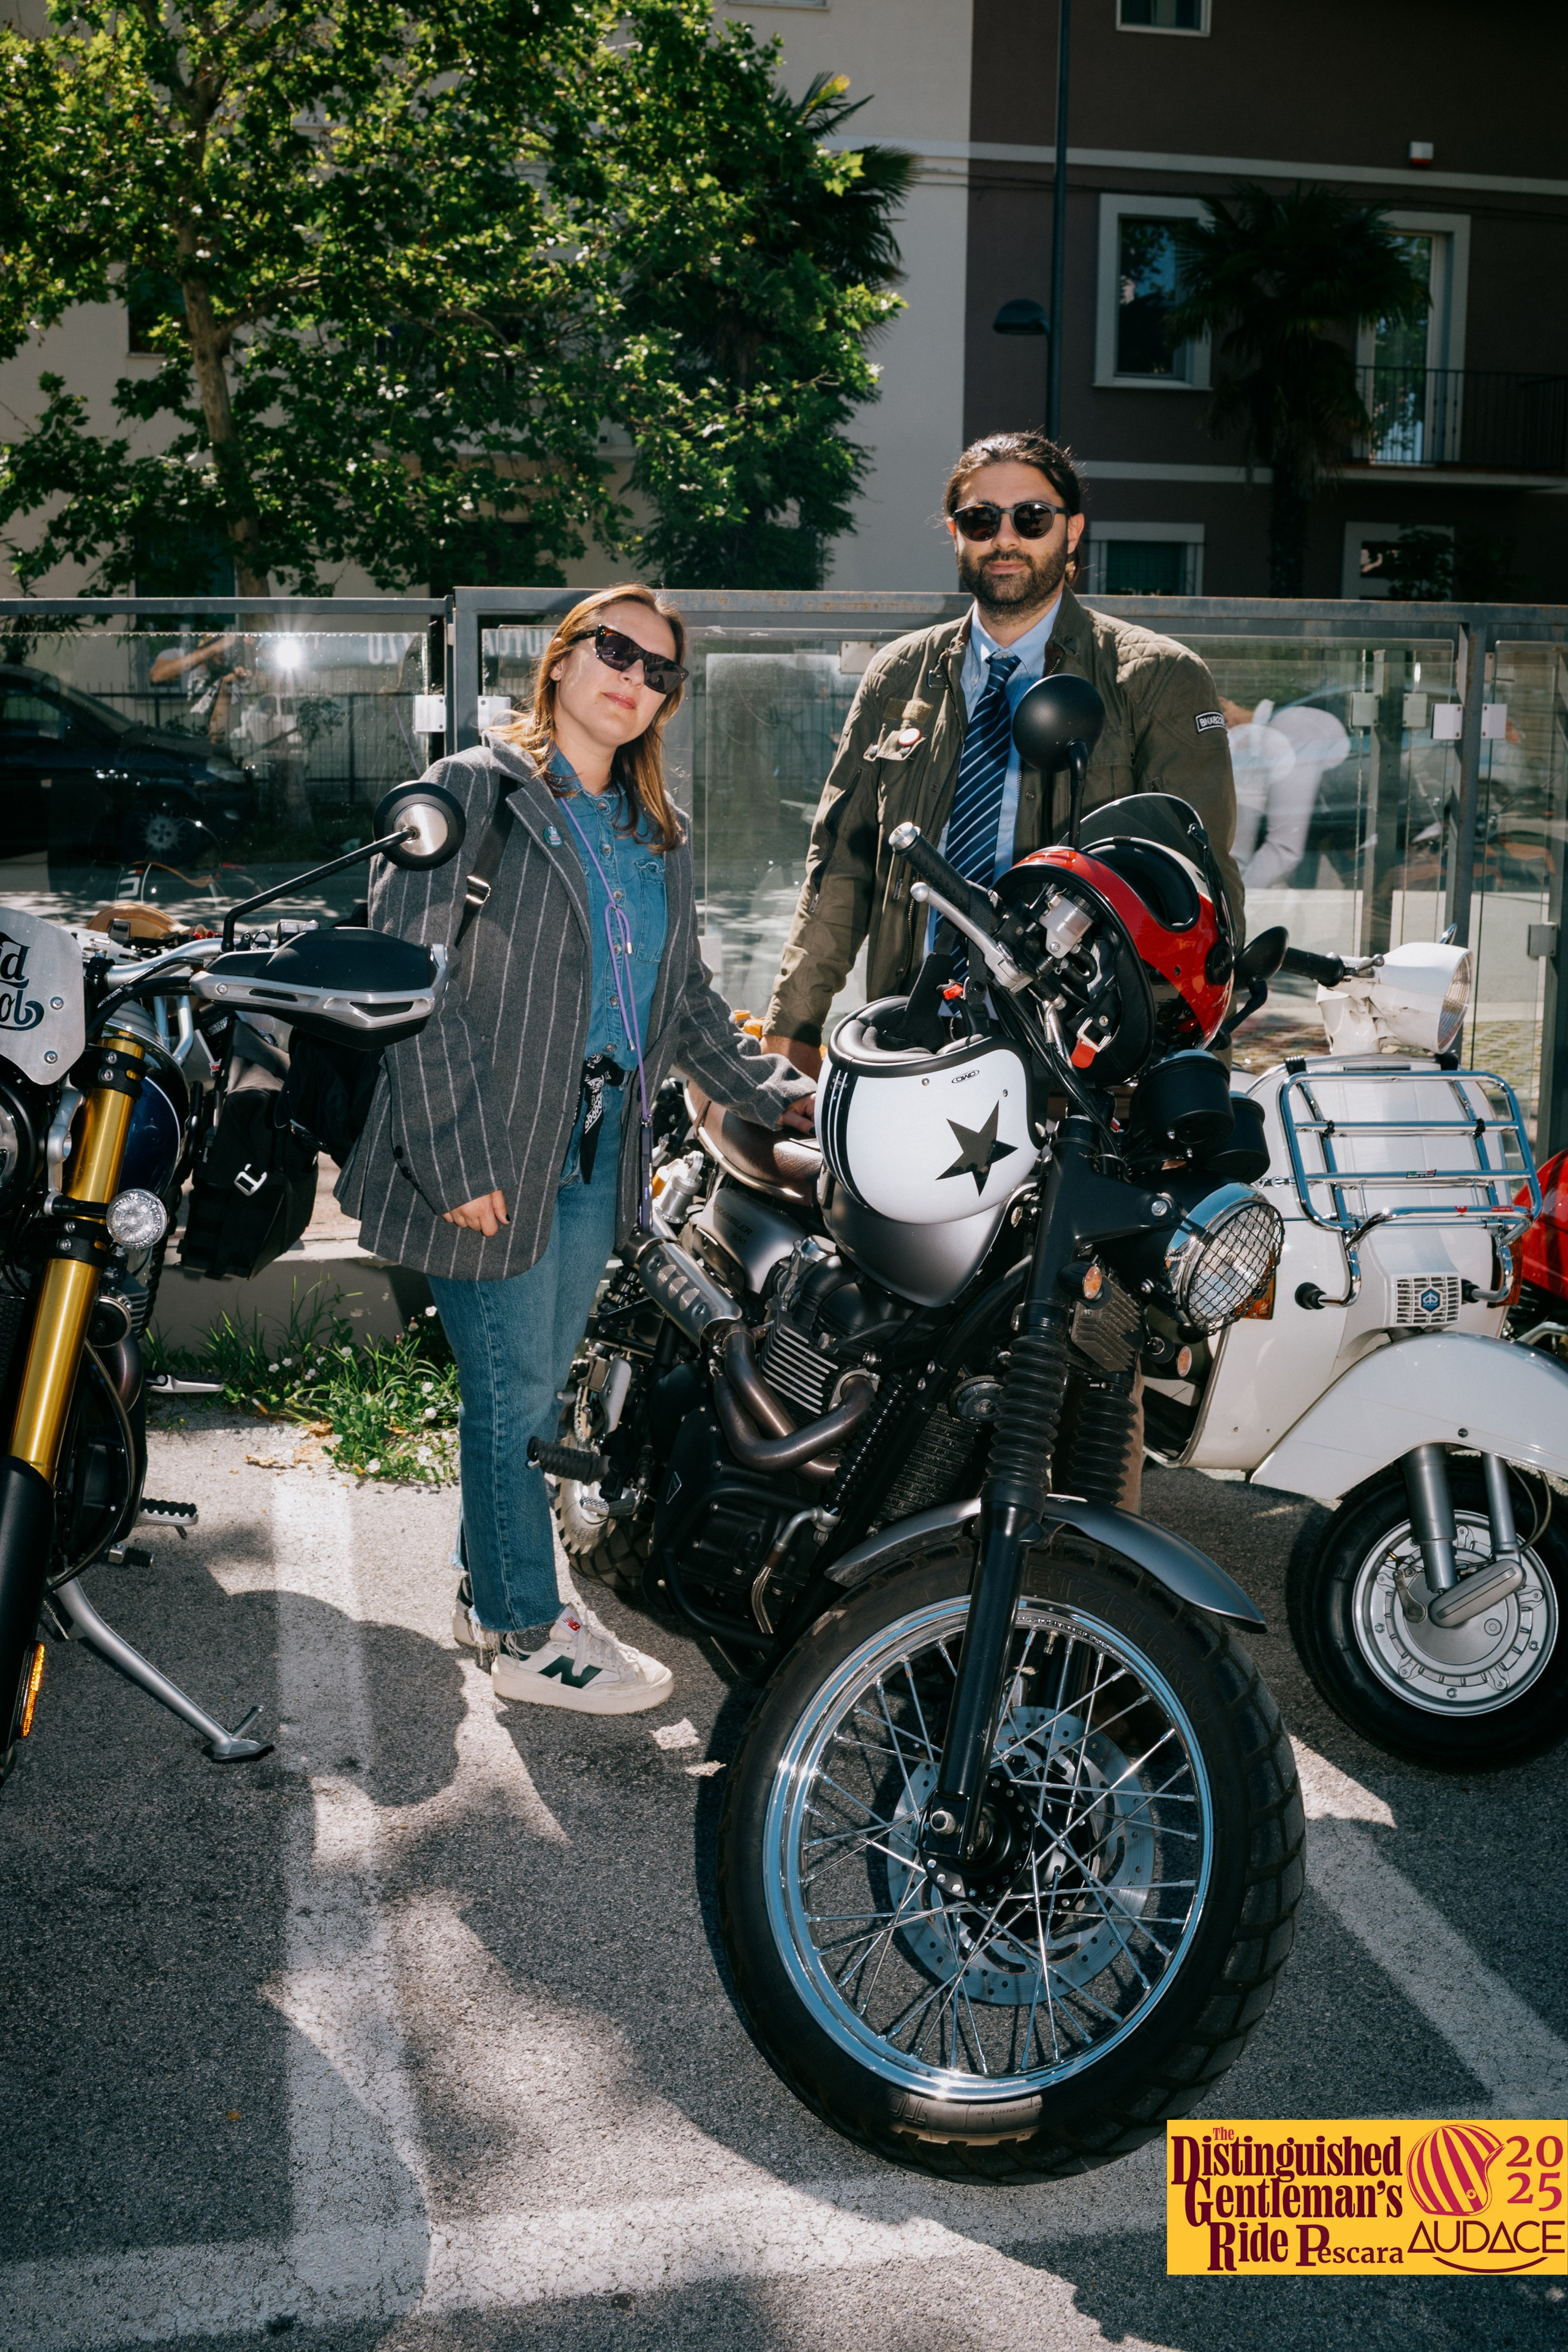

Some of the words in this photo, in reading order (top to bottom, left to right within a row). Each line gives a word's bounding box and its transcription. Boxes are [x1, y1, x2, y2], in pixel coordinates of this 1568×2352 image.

[1254, 1176, 1312, 1189] ves
[710, 1202, 753, 1236] SCRAMBLER
[731, 1232, 747, 1245] 900
[1022, 1565, 1199, 1693] ETZELER
